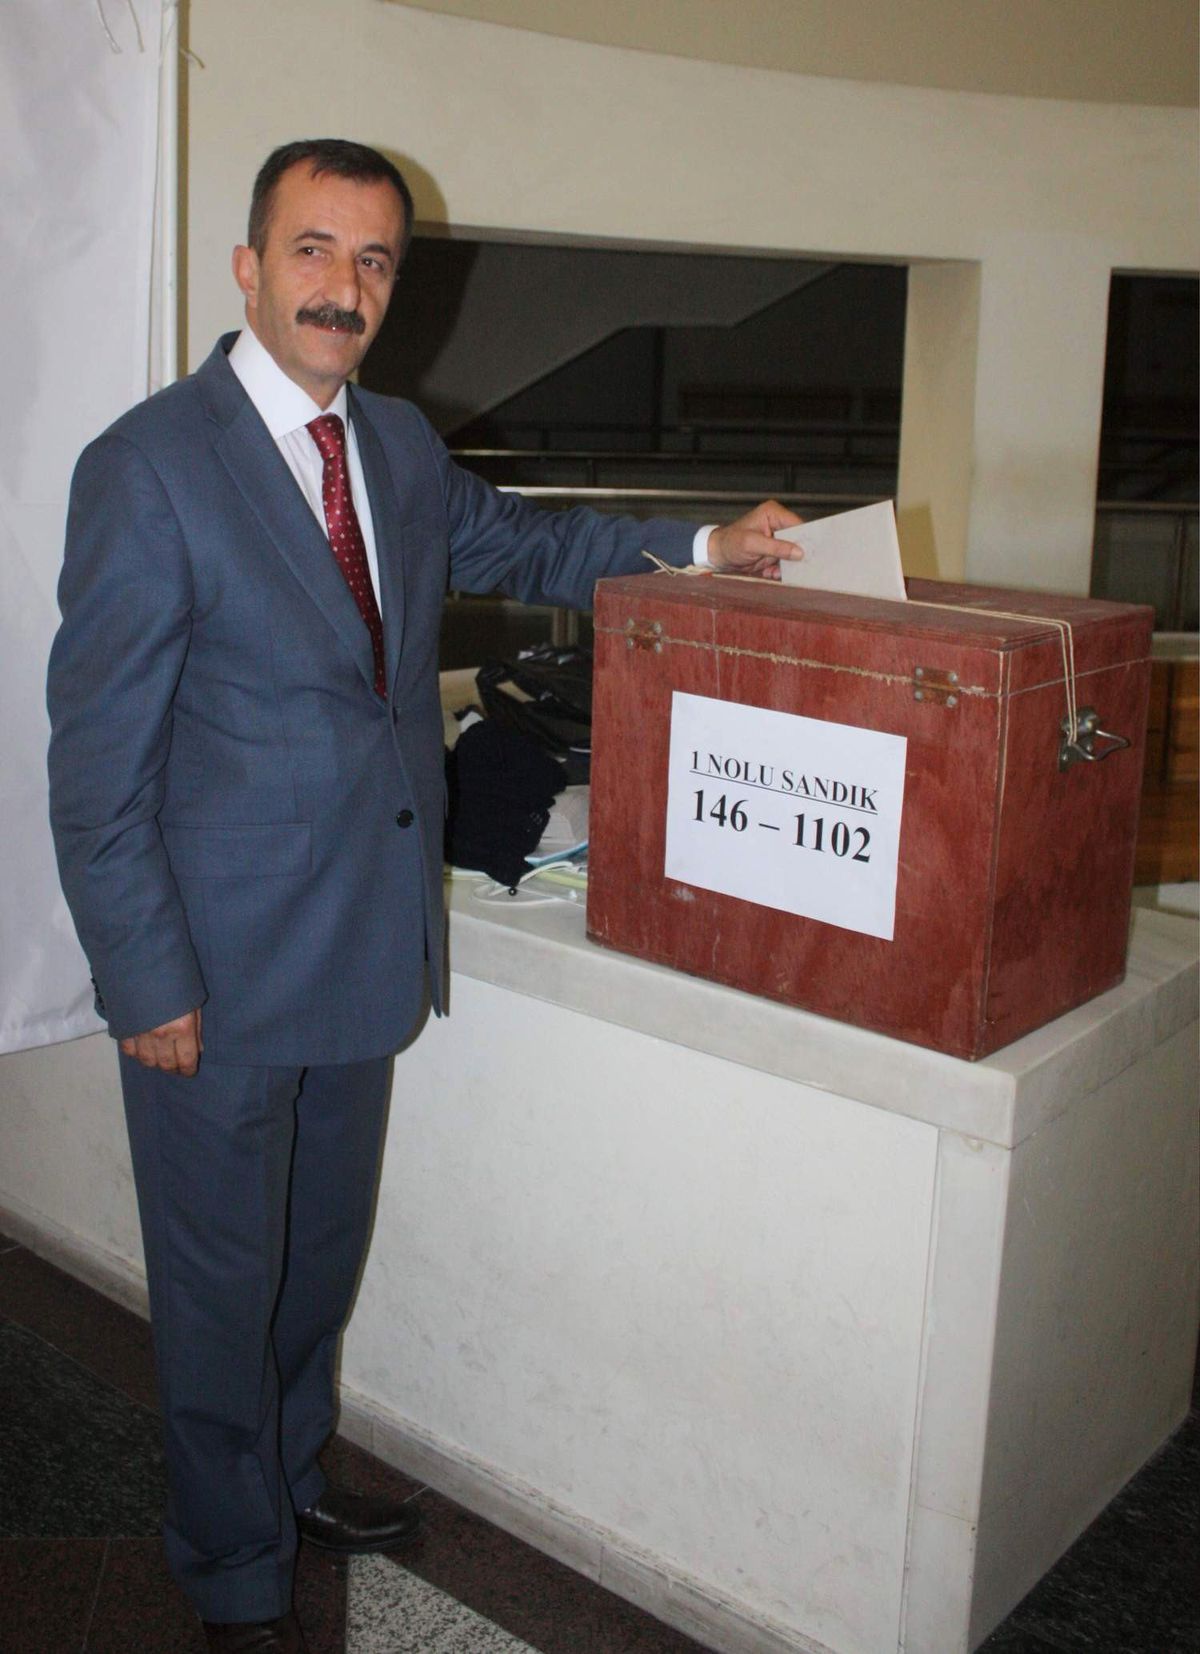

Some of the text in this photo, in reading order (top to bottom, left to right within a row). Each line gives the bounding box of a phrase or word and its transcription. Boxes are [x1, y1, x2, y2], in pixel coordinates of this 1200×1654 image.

[691, 751, 879, 811] 1 NOLU SANDIK
[692, 789, 749, 832] 146
[793, 813, 871, 863] 1102
